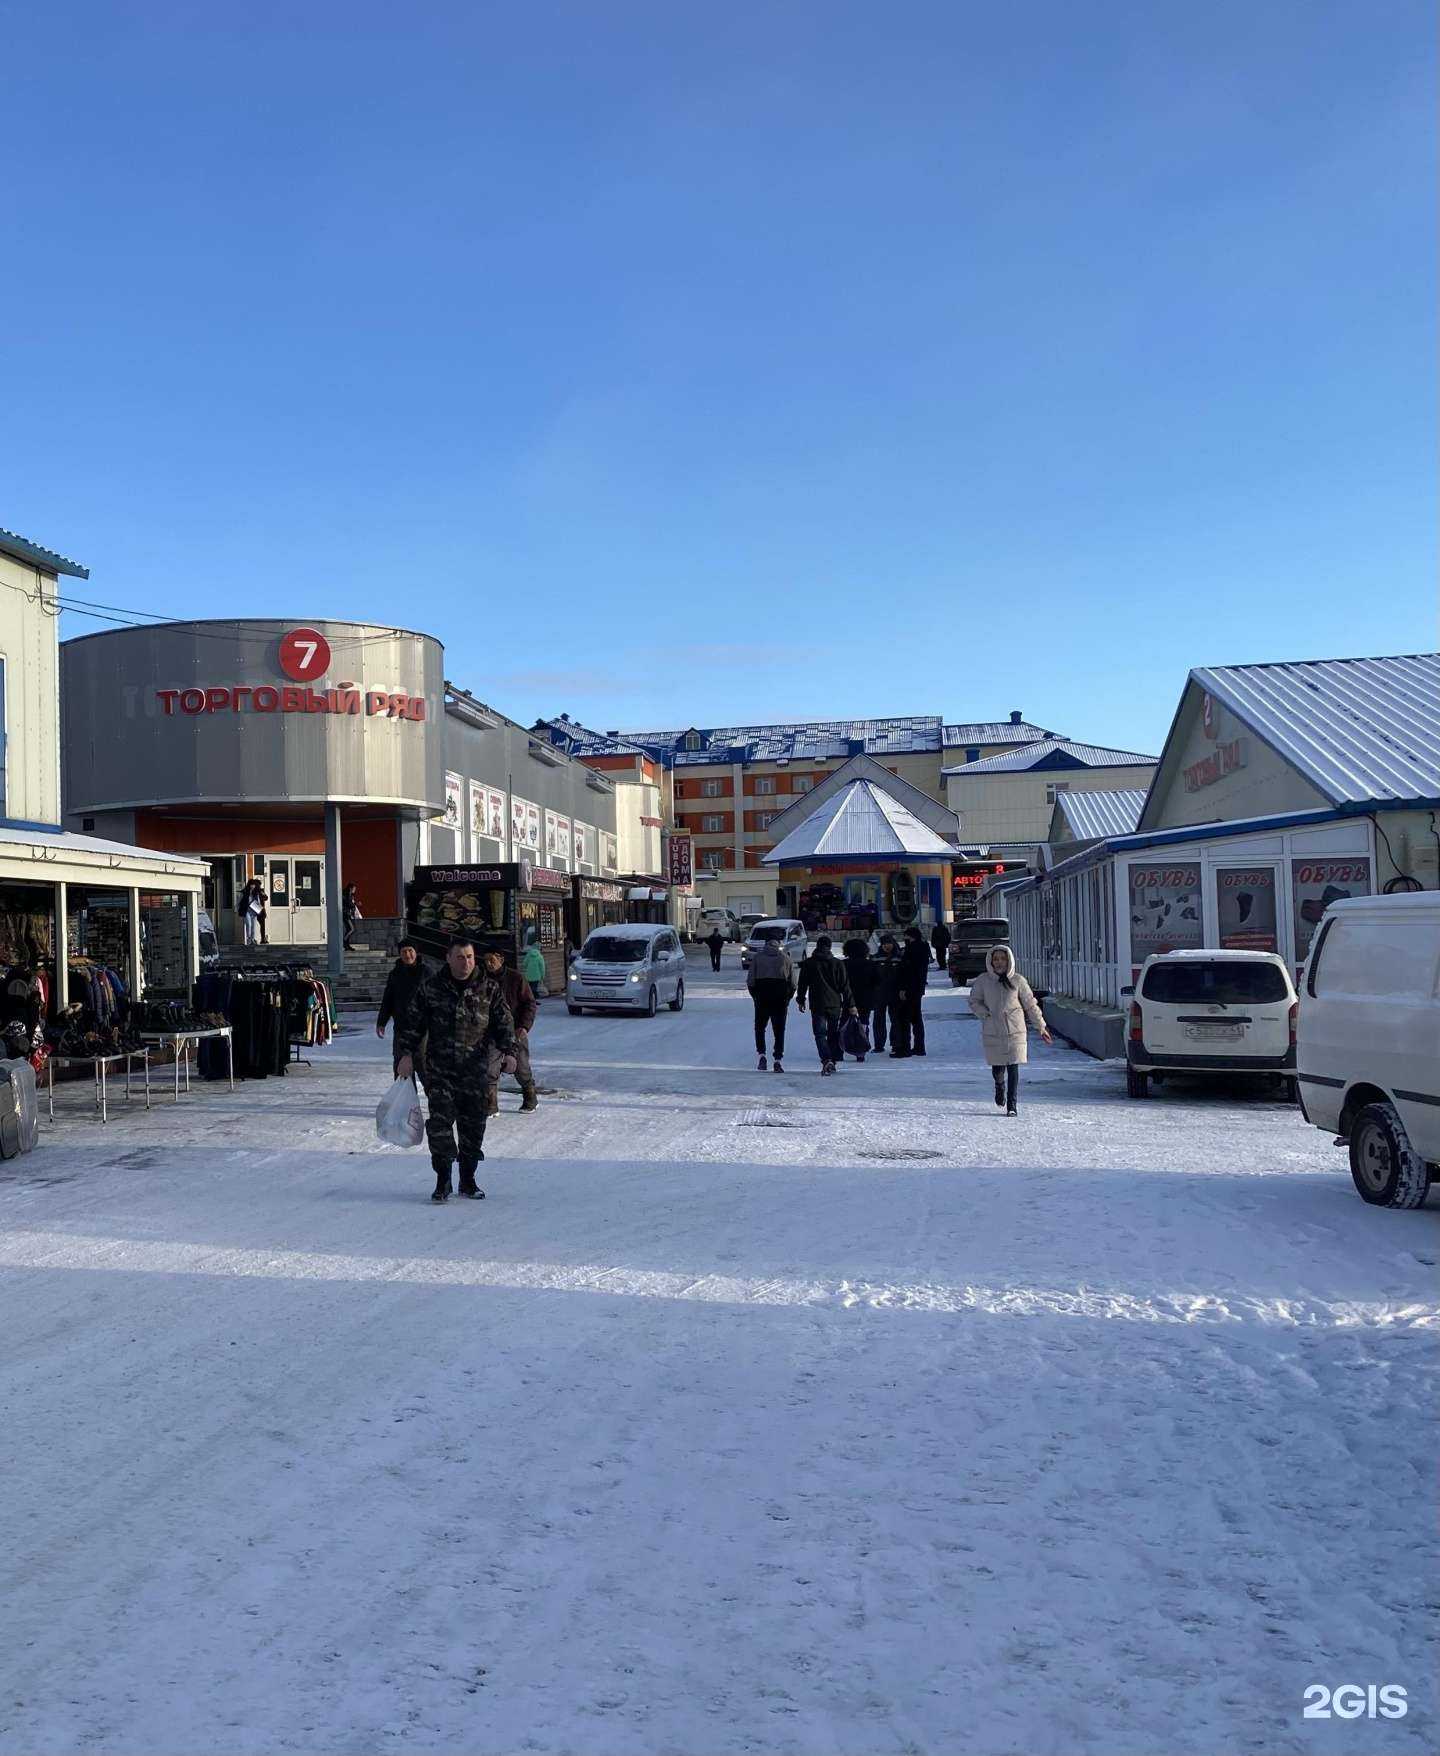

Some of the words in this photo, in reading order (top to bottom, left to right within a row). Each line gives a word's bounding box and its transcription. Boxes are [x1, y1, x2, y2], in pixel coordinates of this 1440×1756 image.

[293, 640, 318, 669] 7
[156, 681, 361, 716] ТОРГОВЫЙ
[365, 691, 426, 721] РЯД
[671, 836, 681, 885] ТОВАРЫ
[681, 844, 690, 884] ДОМА
[431, 869, 502, 882] welcome
[1134, 868, 1197, 888] ОБУВЬ
[1223, 873, 1270, 887] ОБУВЬ
[1300, 863, 1368, 884] ОБУВЬ
